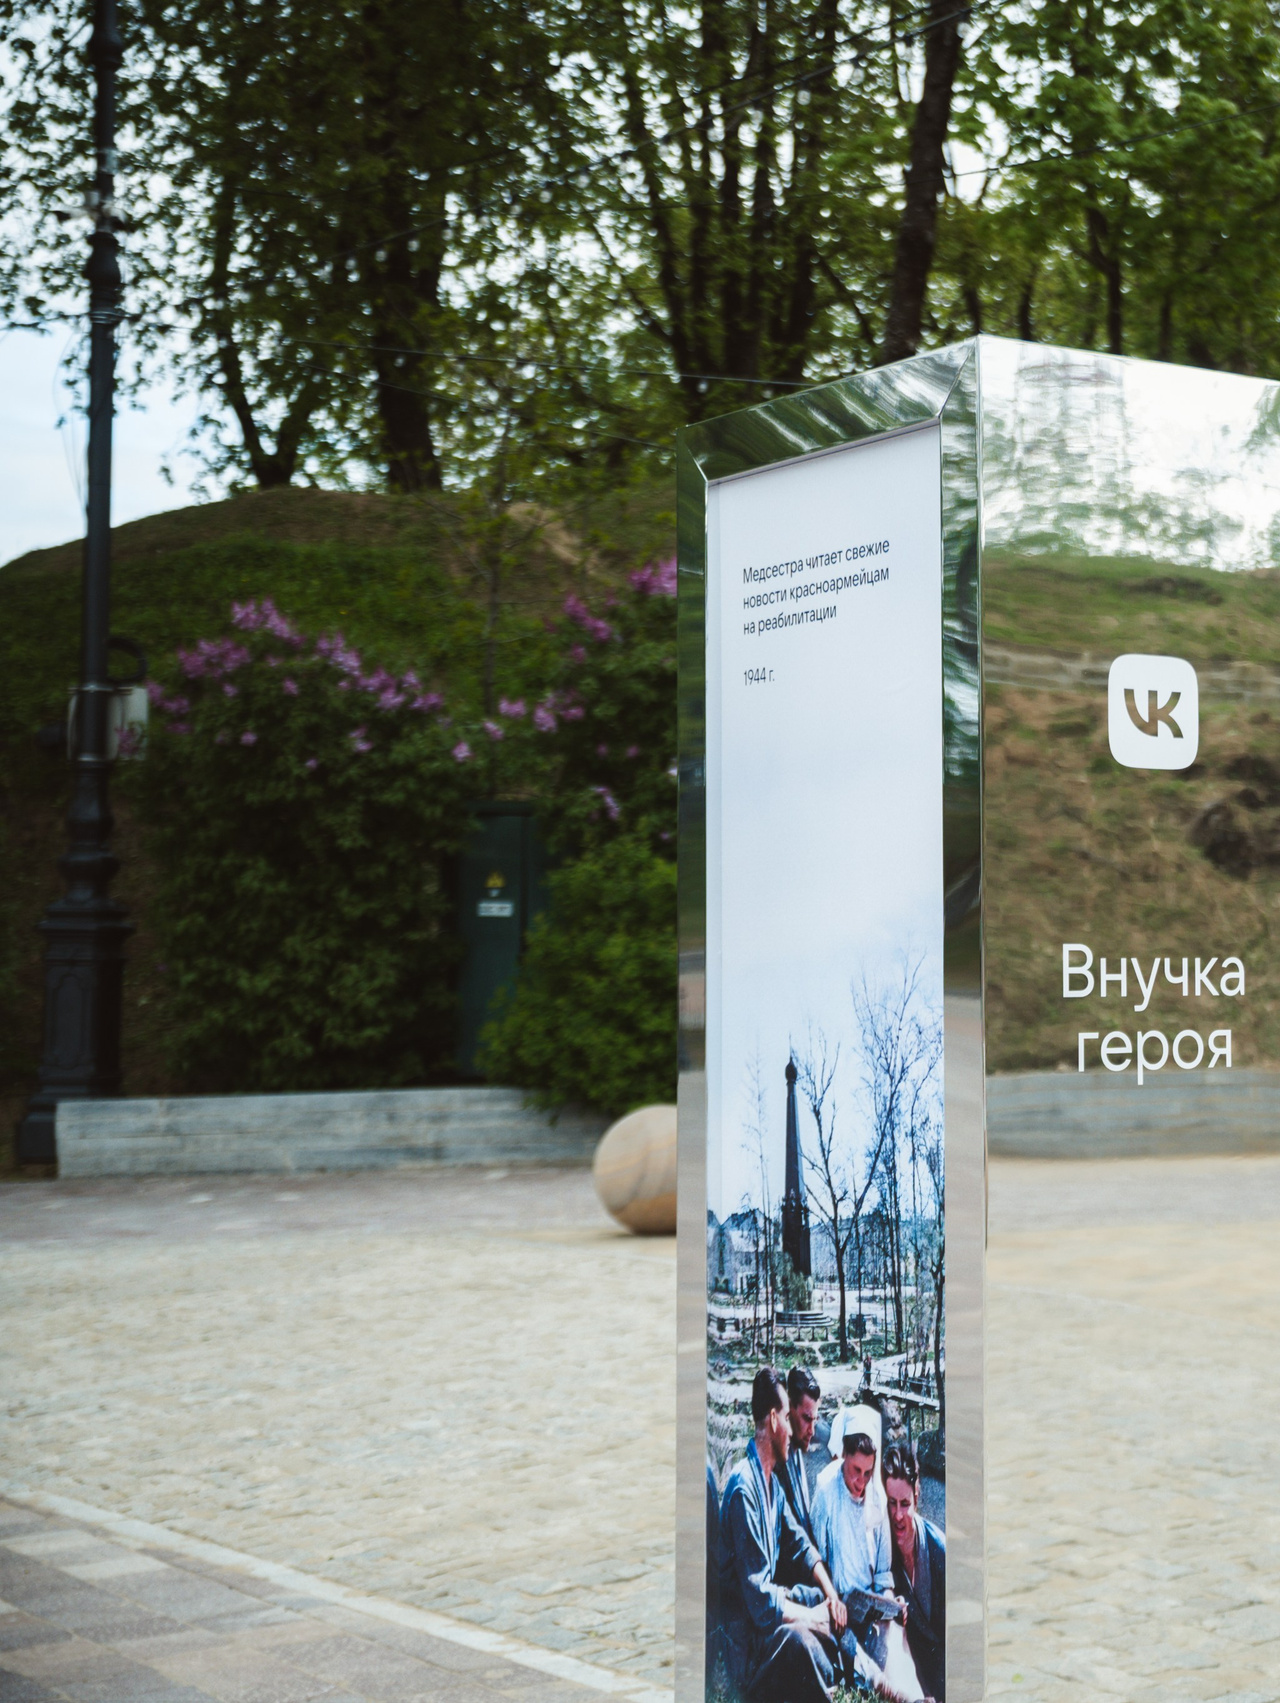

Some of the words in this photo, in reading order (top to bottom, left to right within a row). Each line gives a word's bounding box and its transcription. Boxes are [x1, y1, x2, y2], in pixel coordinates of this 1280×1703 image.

[743, 559, 803, 584] Медсестра
[806, 550, 843, 570] читает
[846, 540, 890, 561] свежие
[743, 589, 787, 609] новости
[790, 567, 890, 602] красноармейцам
[743, 621, 756, 635] на
[758, 605, 837, 636] реабилитации
[744, 667, 766, 686] 1944
[769, 669, 775, 682] г.
[1124, 688, 1183, 738] VK
[1062, 943, 1246, 1012] Внучка
[1078, 1029, 1233, 1085] героя
